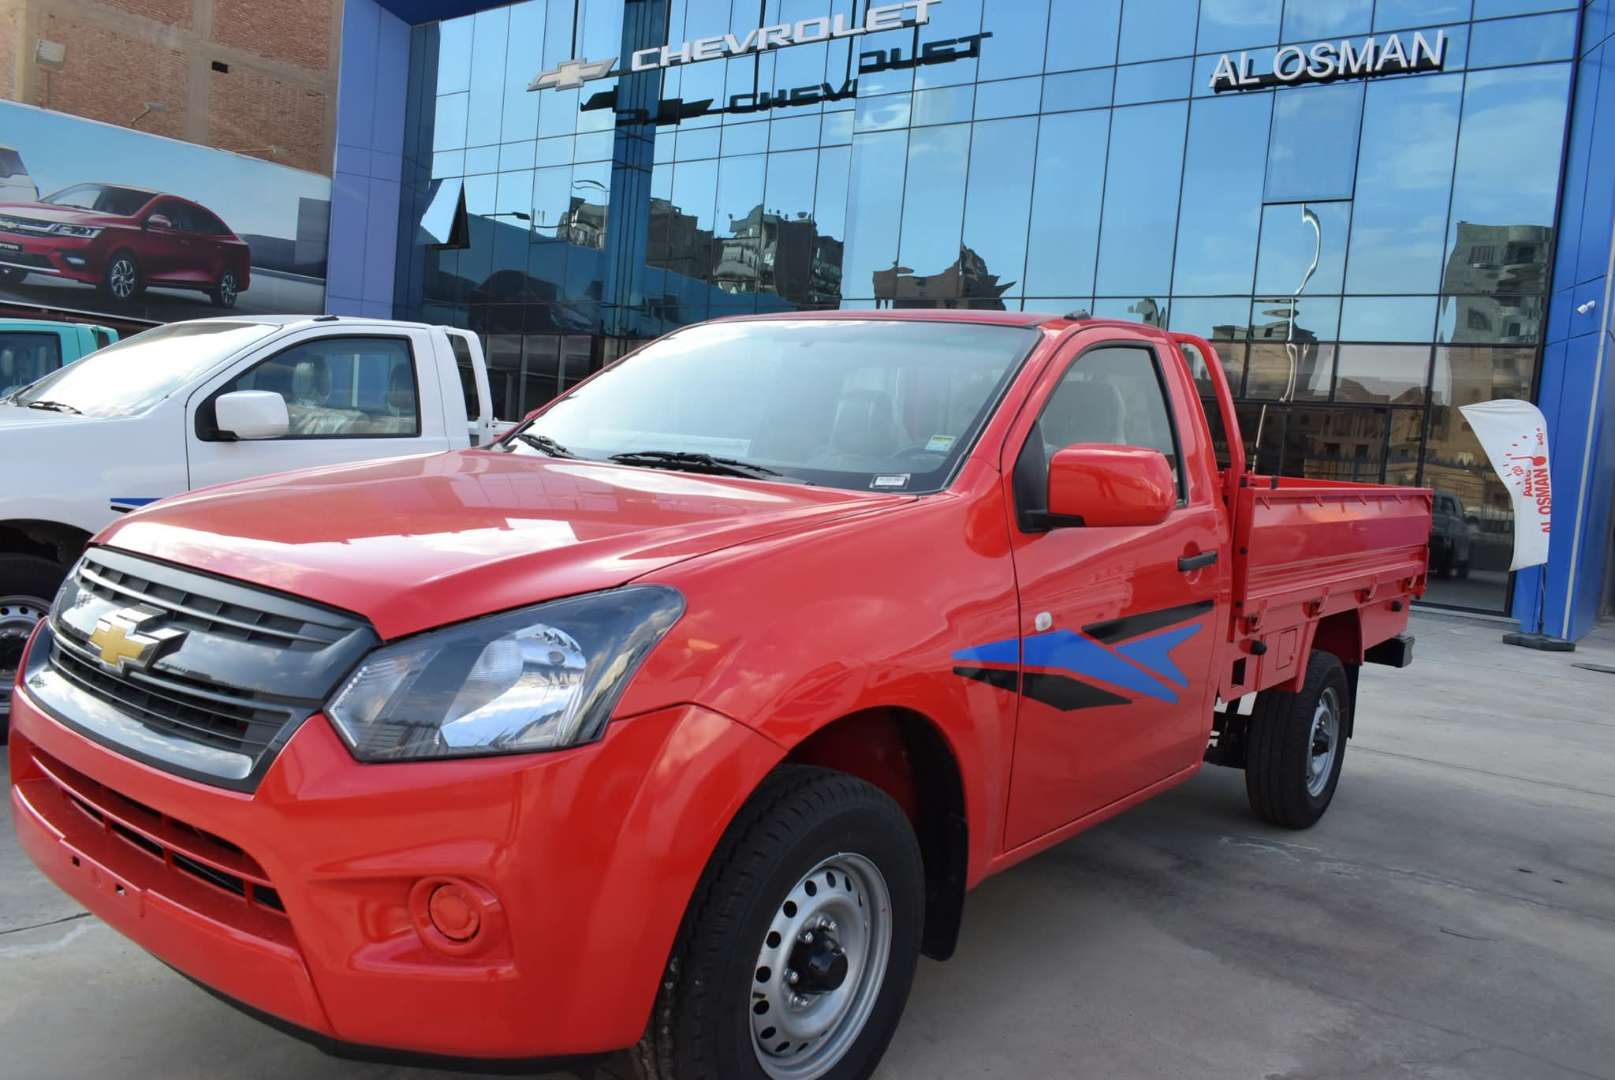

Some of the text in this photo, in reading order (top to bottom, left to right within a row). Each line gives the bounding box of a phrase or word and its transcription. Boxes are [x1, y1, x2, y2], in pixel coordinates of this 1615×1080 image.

[631, 0, 942, 71] CHEVROLET
[1208, 30, 1444, 88] AL OSMAN
